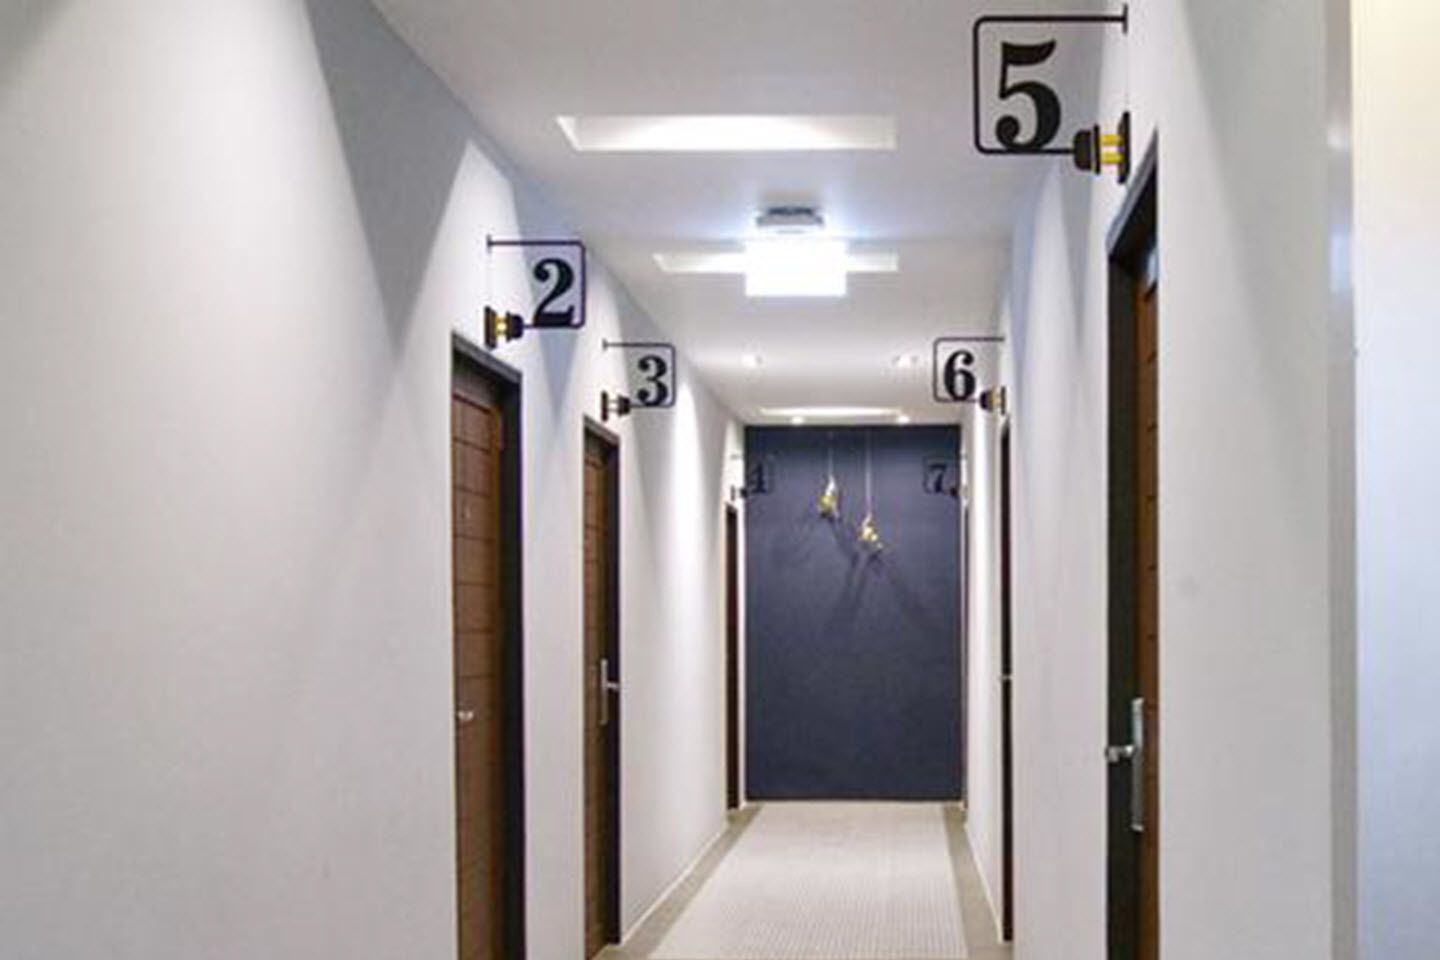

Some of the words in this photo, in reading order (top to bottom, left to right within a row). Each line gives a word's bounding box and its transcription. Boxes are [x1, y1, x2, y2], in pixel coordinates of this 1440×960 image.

[995, 40, 1061, 151] 5
[533, 258, 575, 327] 2
[636, 355, 668, 406] 3
[943, 350, 976, 401] 6
[925, 462, 949, 493] 7
